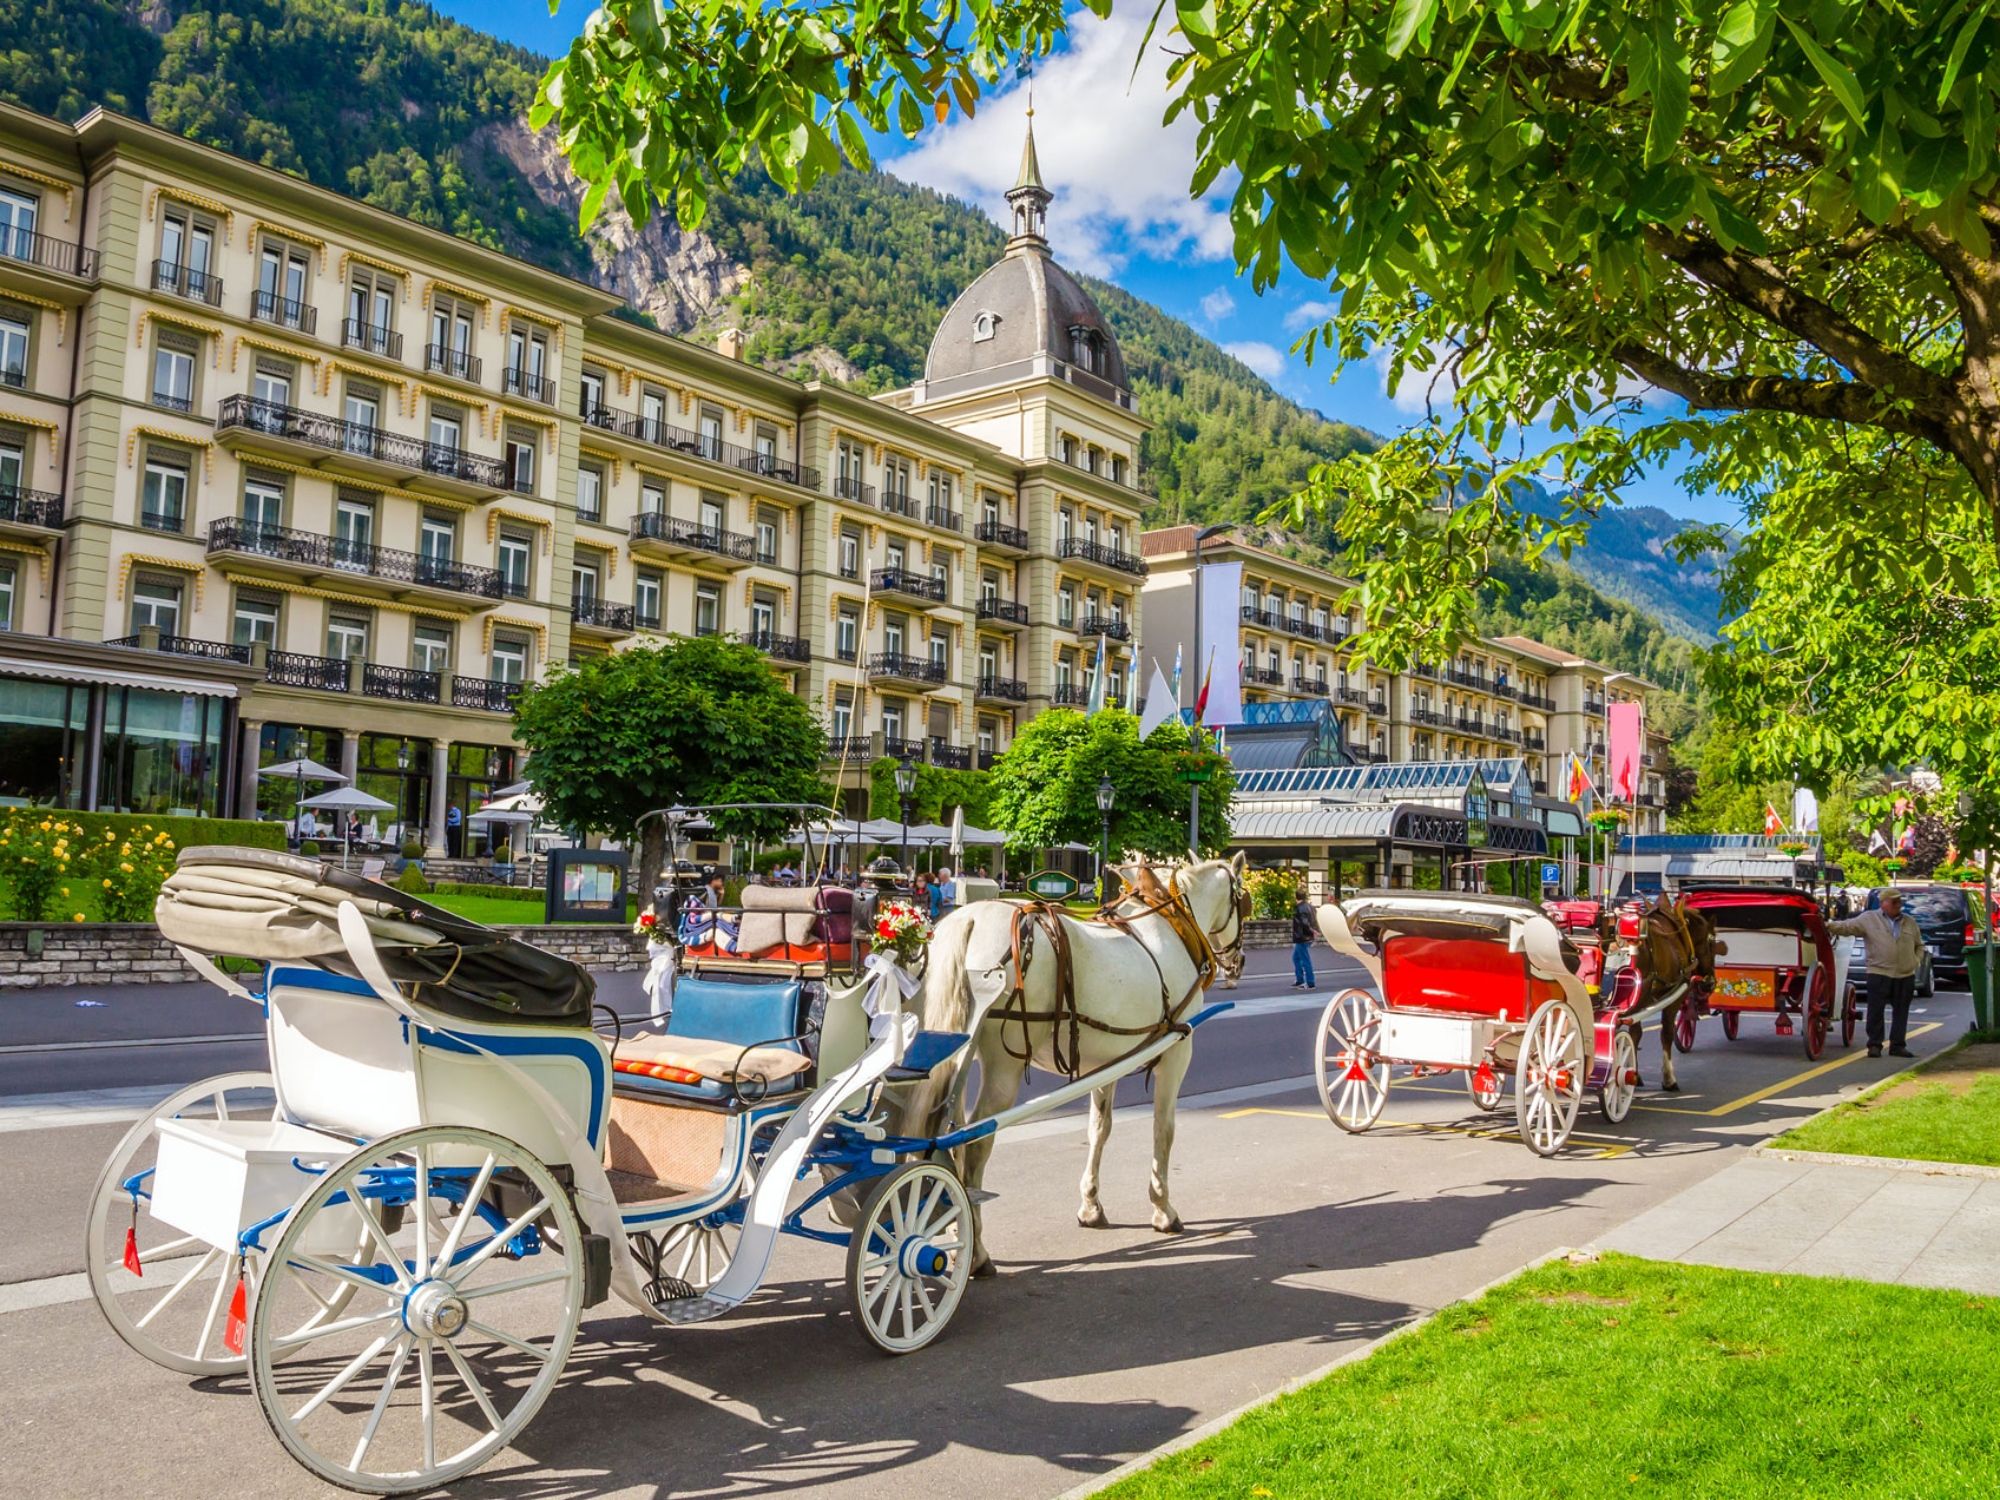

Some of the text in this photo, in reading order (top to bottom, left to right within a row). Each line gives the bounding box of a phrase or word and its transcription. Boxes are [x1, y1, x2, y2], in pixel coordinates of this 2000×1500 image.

[1546, 868, 1554, 878] P
[1483, 1079, 1495, 1092] 76
[233, 1320, 246, 1348] 80
